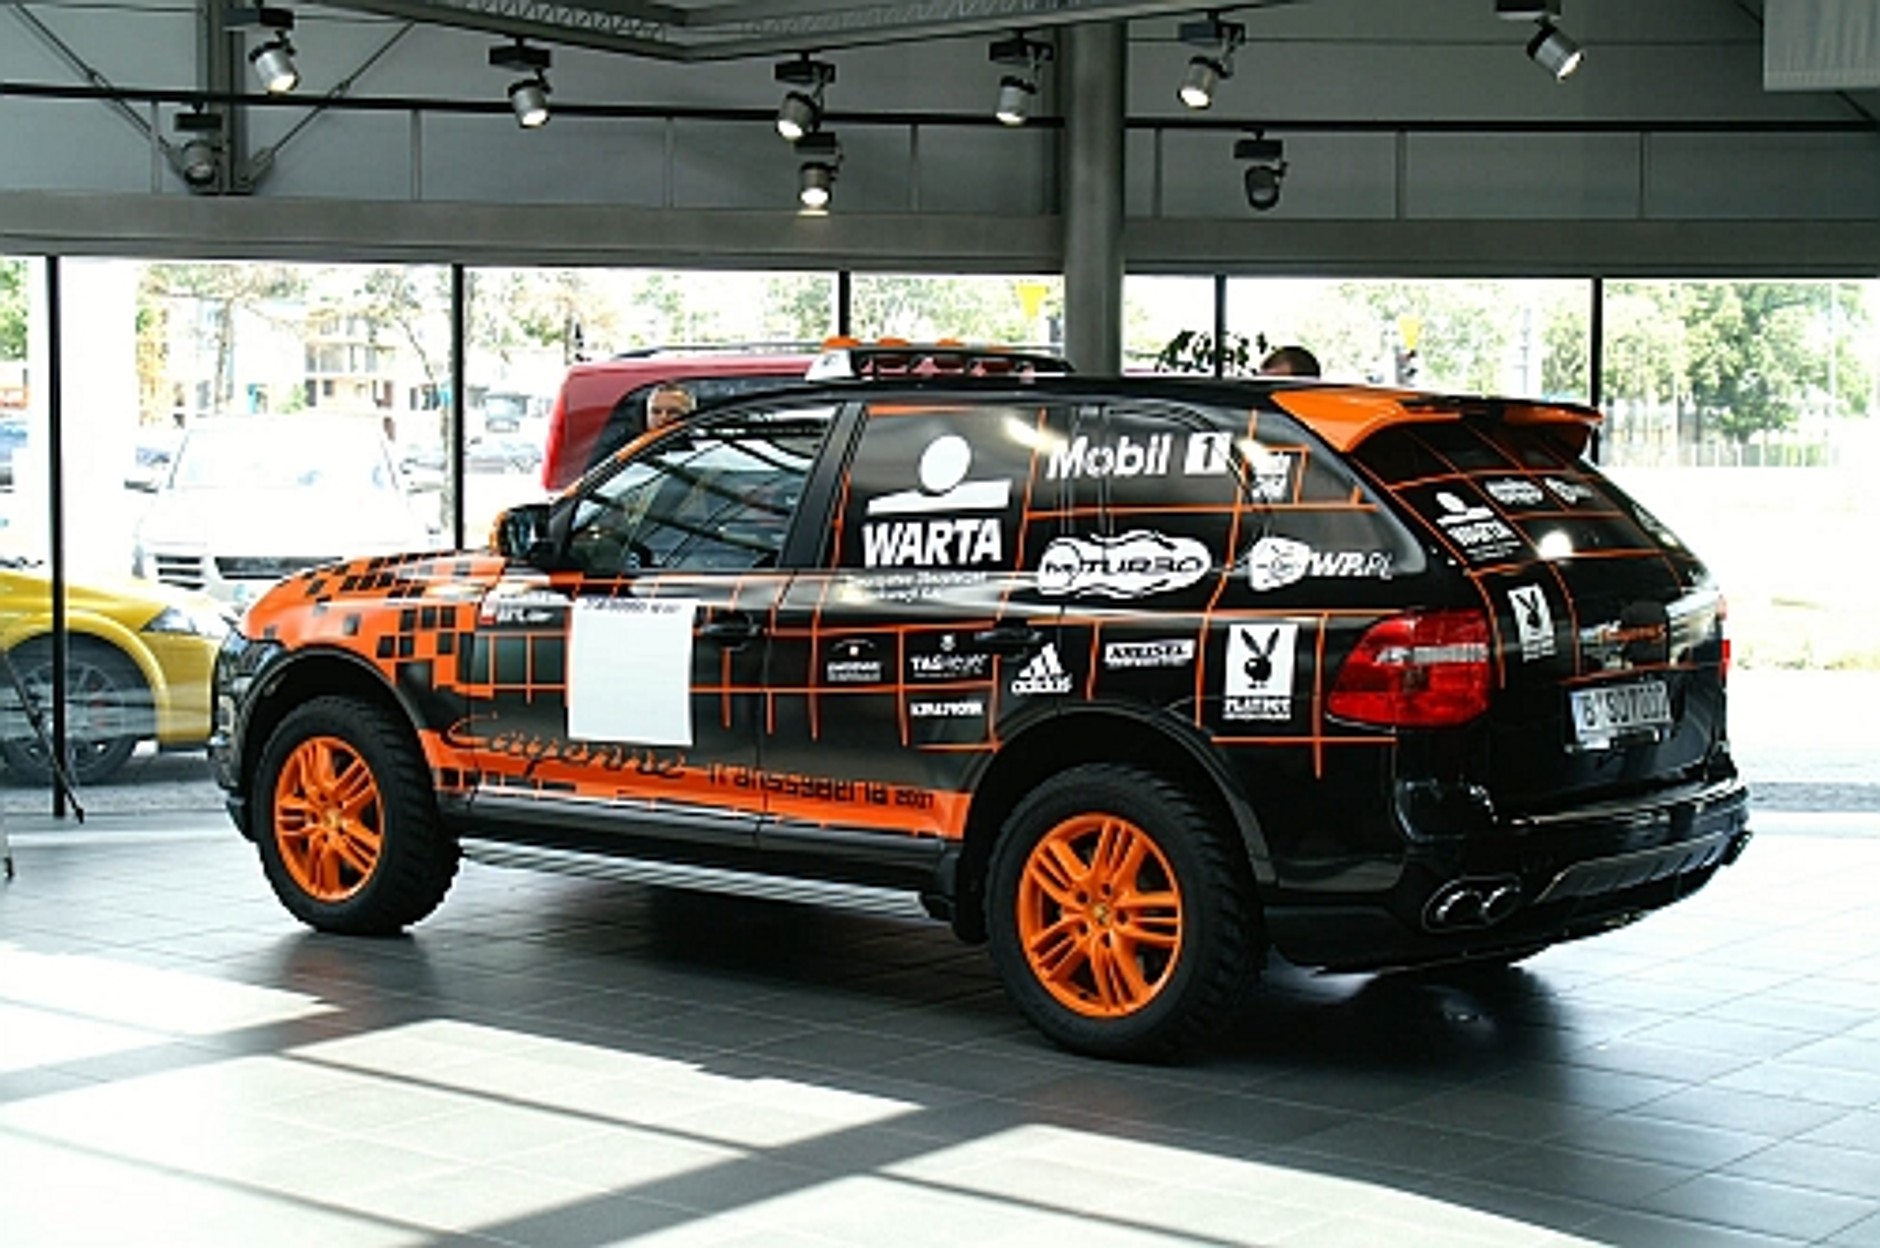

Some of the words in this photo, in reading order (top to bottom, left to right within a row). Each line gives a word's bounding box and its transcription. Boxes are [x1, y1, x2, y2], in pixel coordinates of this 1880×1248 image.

[1046, 434, 1173, 479] Mobil
[862, 518, 1003, 569] WARTA
[1011, 674, 1073, 694] adidas
[440, 710, 685, 779] Cayenne
